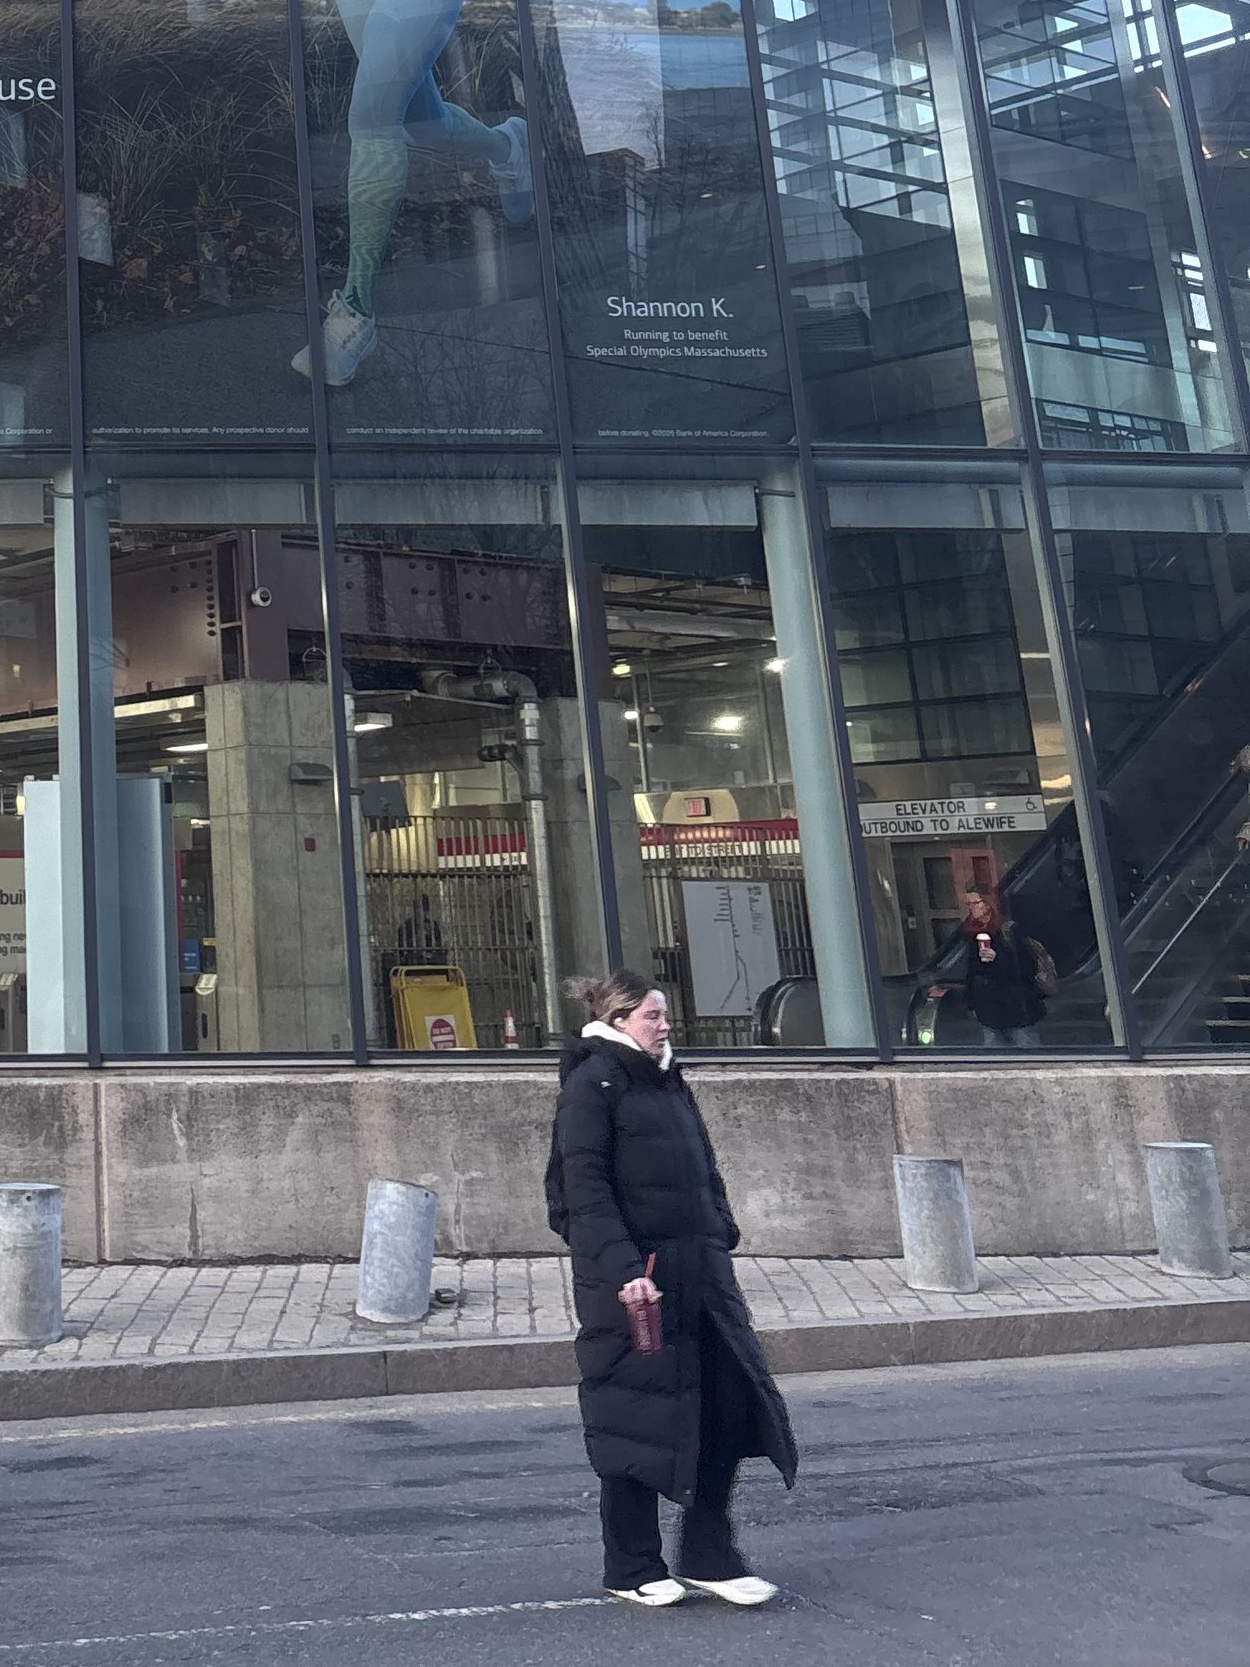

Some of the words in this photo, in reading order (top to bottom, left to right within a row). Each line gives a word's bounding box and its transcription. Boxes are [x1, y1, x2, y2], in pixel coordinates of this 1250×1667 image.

[607, 296, 704, 318] Shannon
[711, 297, 734, 318] K.
[624, 329, 670, 343] Running
[672, 331, 685, 341] to
[687, 329, 729, 341] benefit
[586, 344, 627, 357] Special
[630, 345, 682, 359] Olympics
[684, 346, 768, 358] Massachusetts
[896, 801, 966, 816] ELEVATOR
[860, 820, 924, 835] UTBOUND
[930, 818, 949, 831] TO
[957, 816, 1016, 831] ALEWIFE
